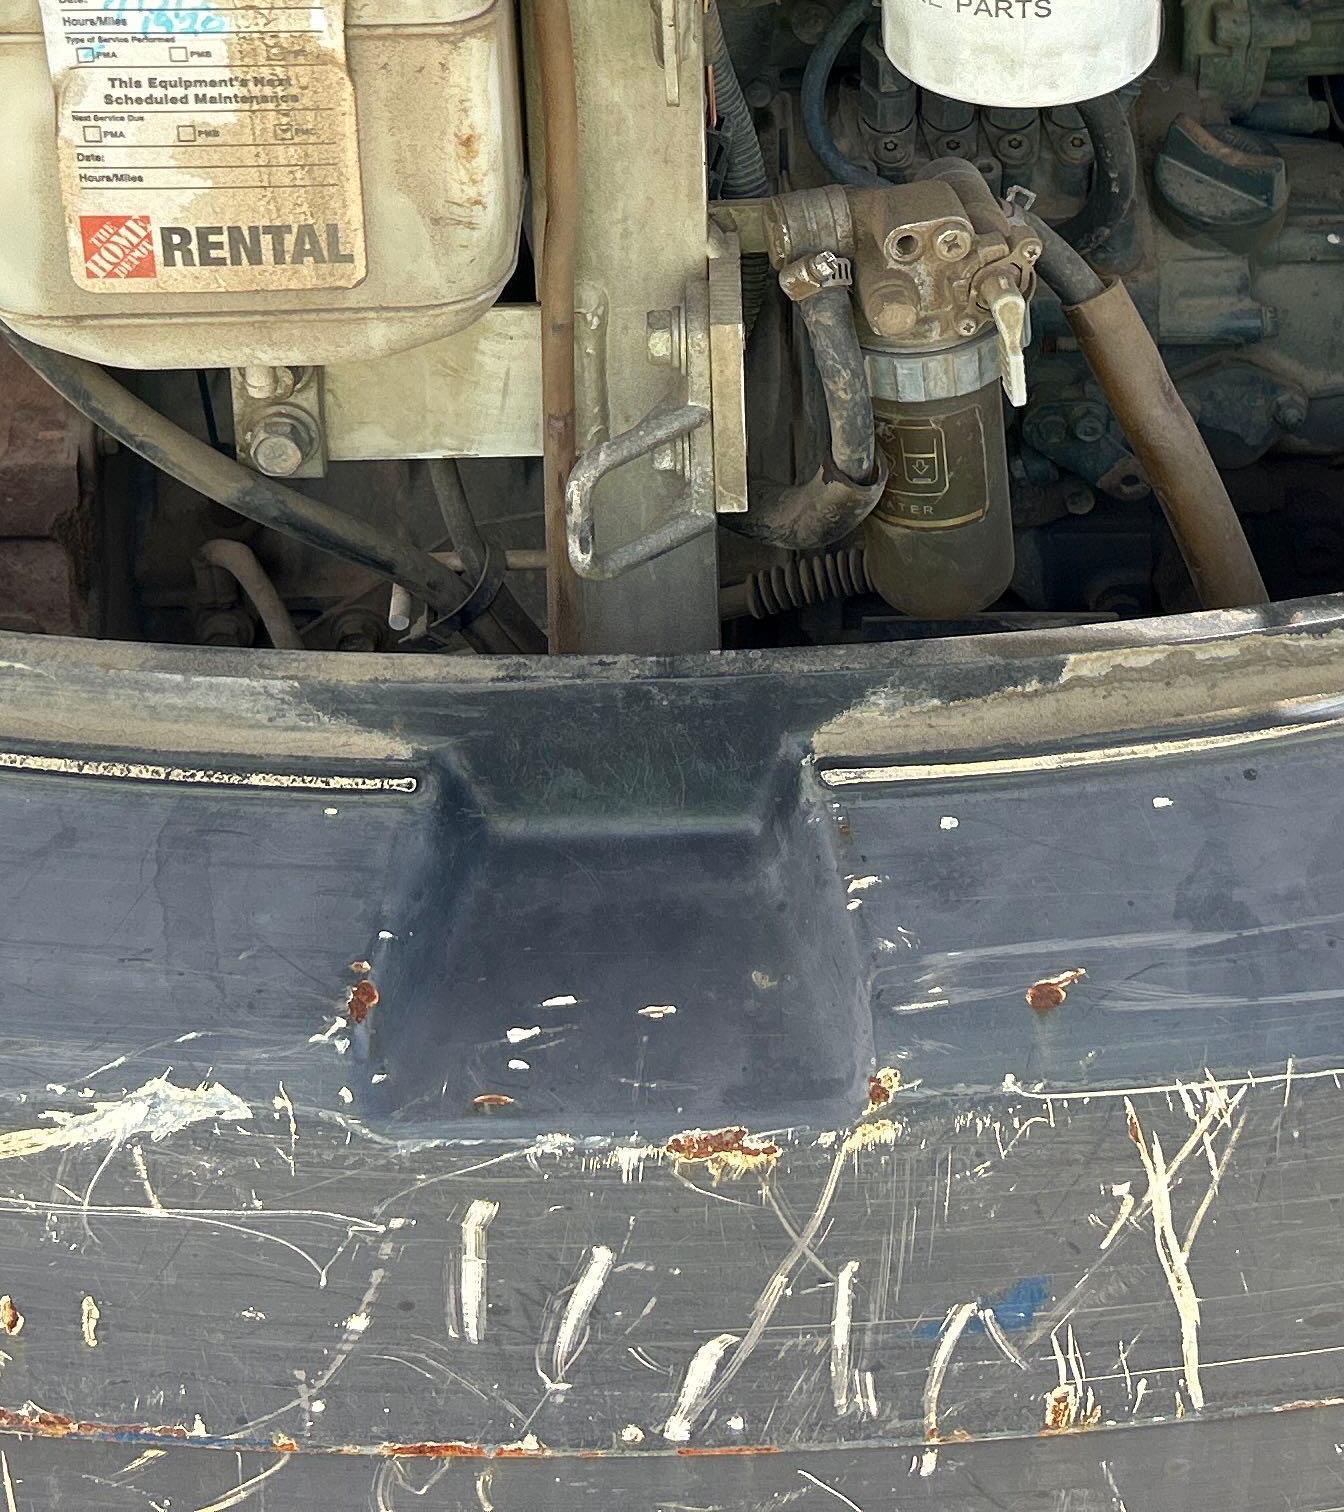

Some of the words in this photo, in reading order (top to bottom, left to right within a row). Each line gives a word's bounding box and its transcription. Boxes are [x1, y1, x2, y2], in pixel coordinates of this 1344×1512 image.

[62, 16, 128, 27] Hours/Miles
[65, 36, 85, 45] Type
[87, 35, 95, 43] of
[97, 35, 129, 43] Service
[131, 35, 176, 43] Performed
[108, 76, 142, 89] This
[147, 76, 248, 90] Equipment's
[253, 75, 292, 88] Next
[103, 93, 189, 106] Scheduled
[194, 92, 300, 105] Maintenance
[71, 114, 91, 122] Next
[93, 114, 125, 122] Service
[127, 114, 144, 122] Due
[76, 152, 105, 163] Date:
[79, 173, 144, 183] Hours/Miles
[89, 222, 118, 248] THE
[84, 216, 152, 279] HOME
[159, 223, 355, 268] RENTAL
[113, 239, 154, 279] DEPOT
[886, 501, 934, 515] ATER
